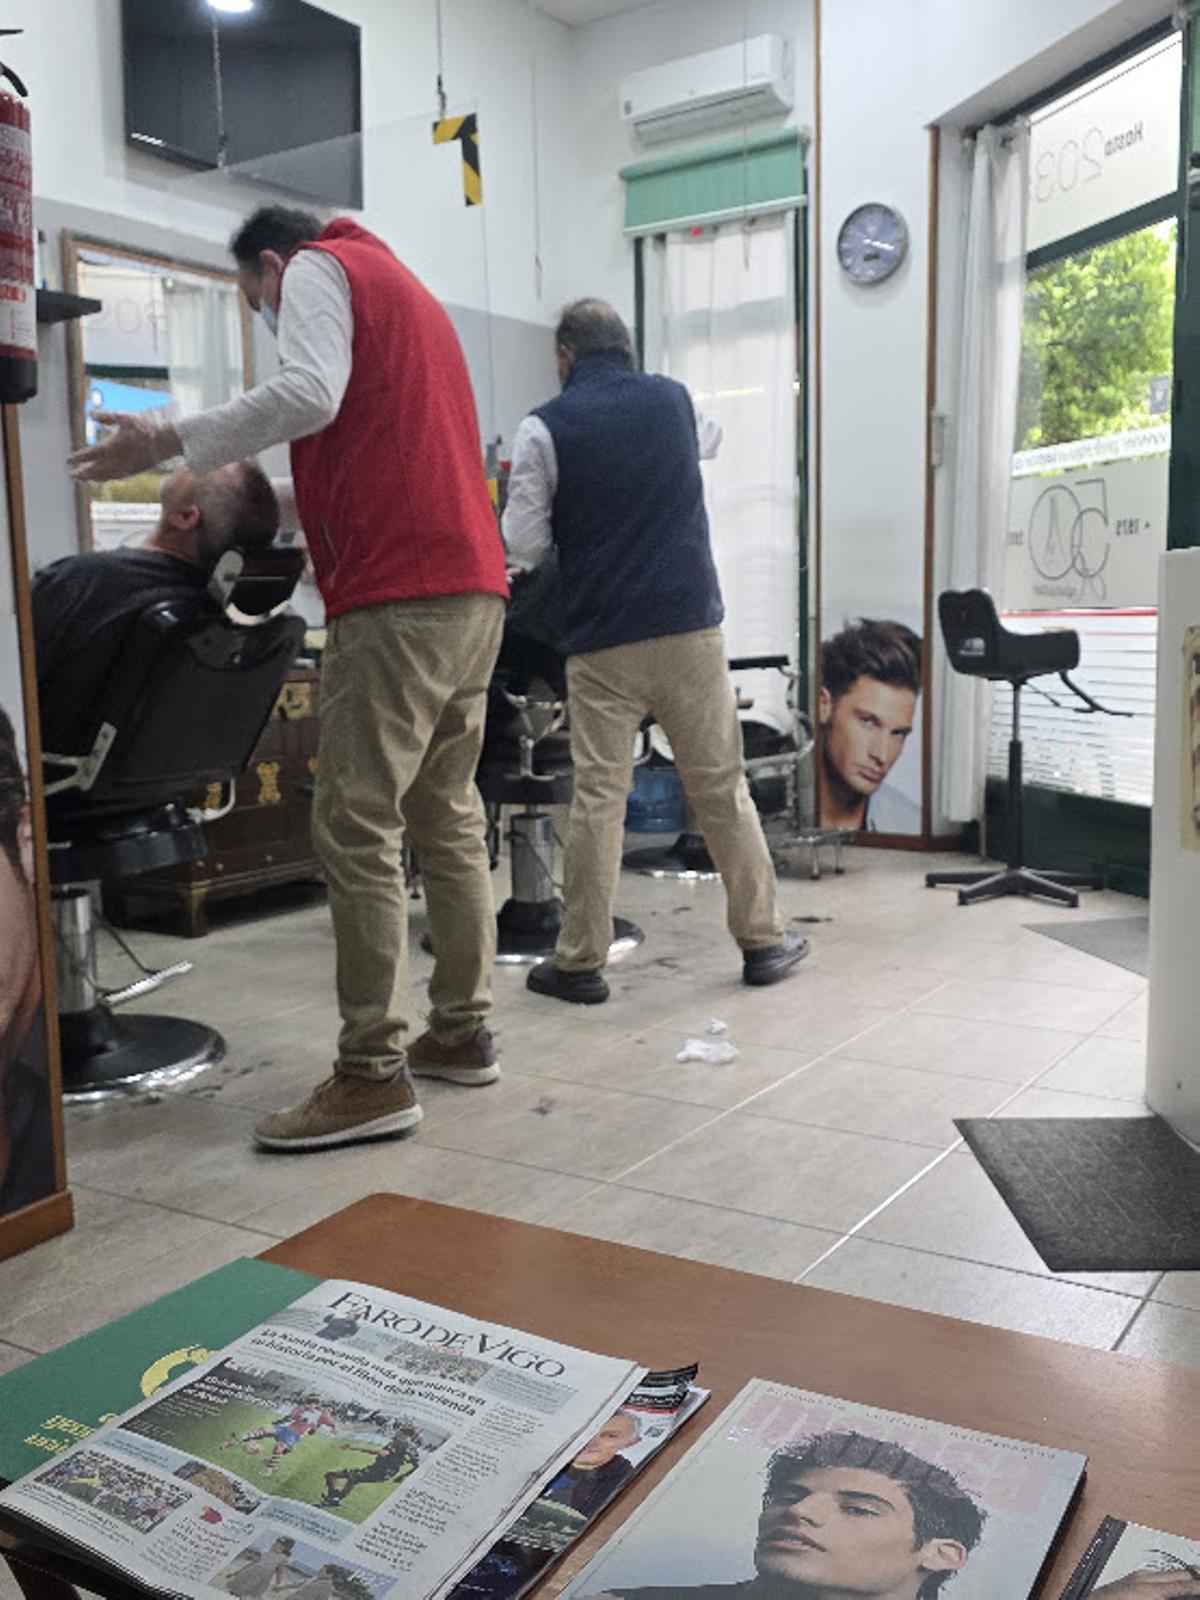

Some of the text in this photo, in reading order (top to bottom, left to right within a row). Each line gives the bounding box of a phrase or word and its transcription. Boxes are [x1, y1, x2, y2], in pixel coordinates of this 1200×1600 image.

[328, 1291, 423, 1335] FARO
[420, 1322, 473, 1348] DE
[475, 1332, 566, 1379] VIGO
